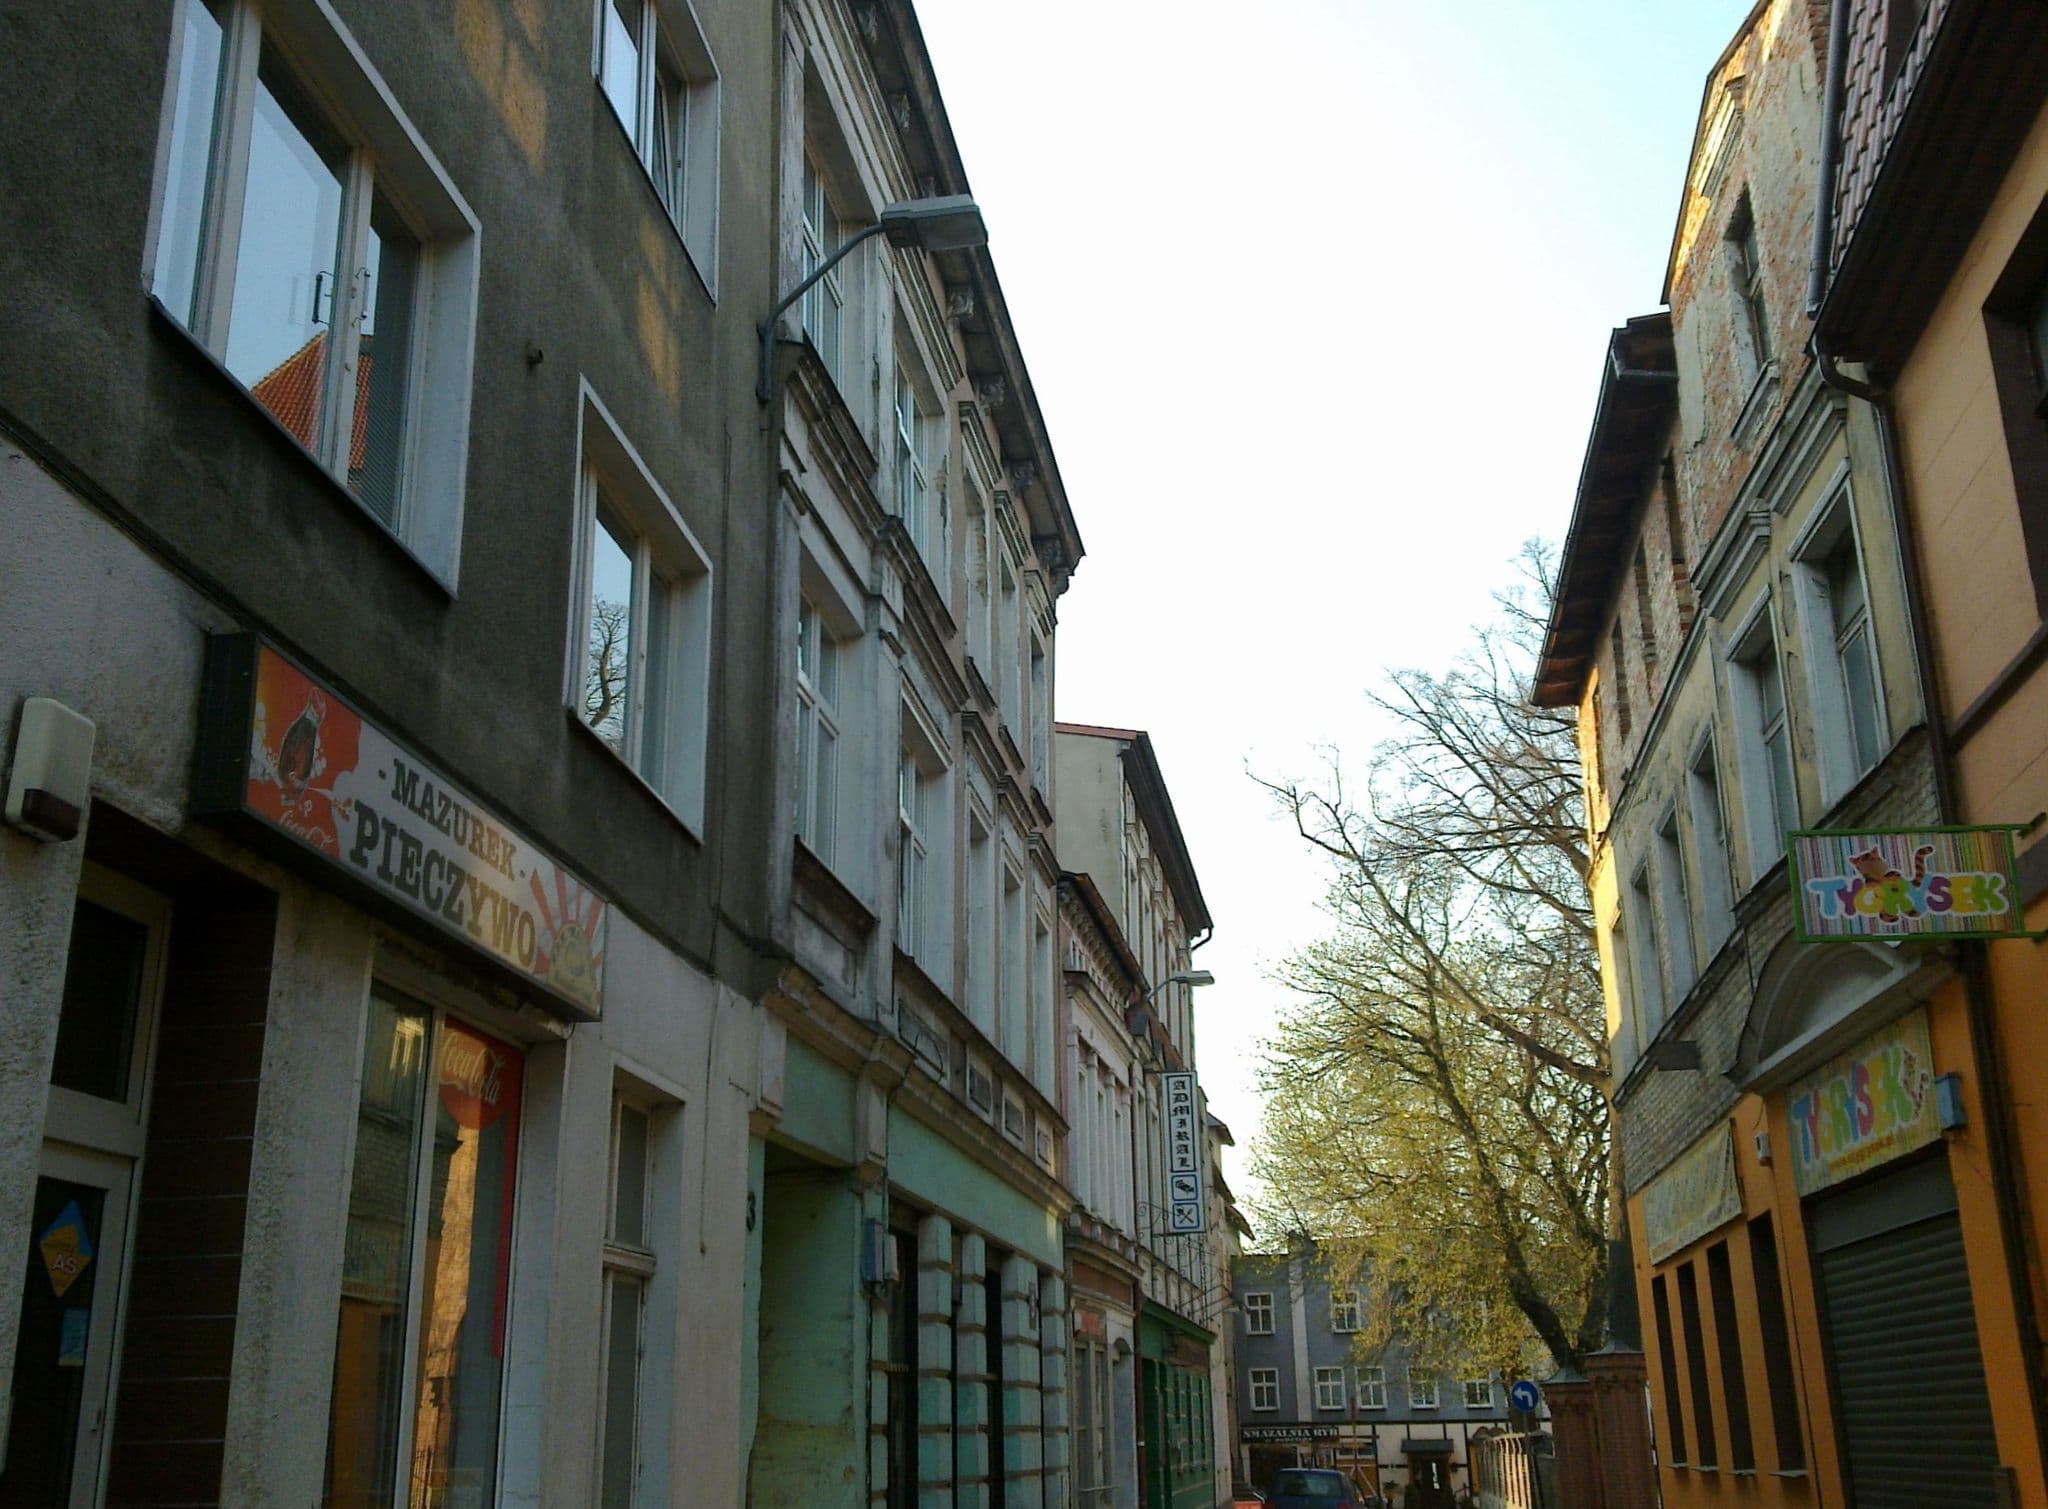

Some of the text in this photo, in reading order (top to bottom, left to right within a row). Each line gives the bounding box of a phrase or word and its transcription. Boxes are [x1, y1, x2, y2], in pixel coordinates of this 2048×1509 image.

[391, 758, 517, 881] MAZUREK
[349, 800, 537, 971] PIECZYWO
[1809, 871, 2008, 917] TYGRYSEK
[52, 1253, 78, 1274] AS
